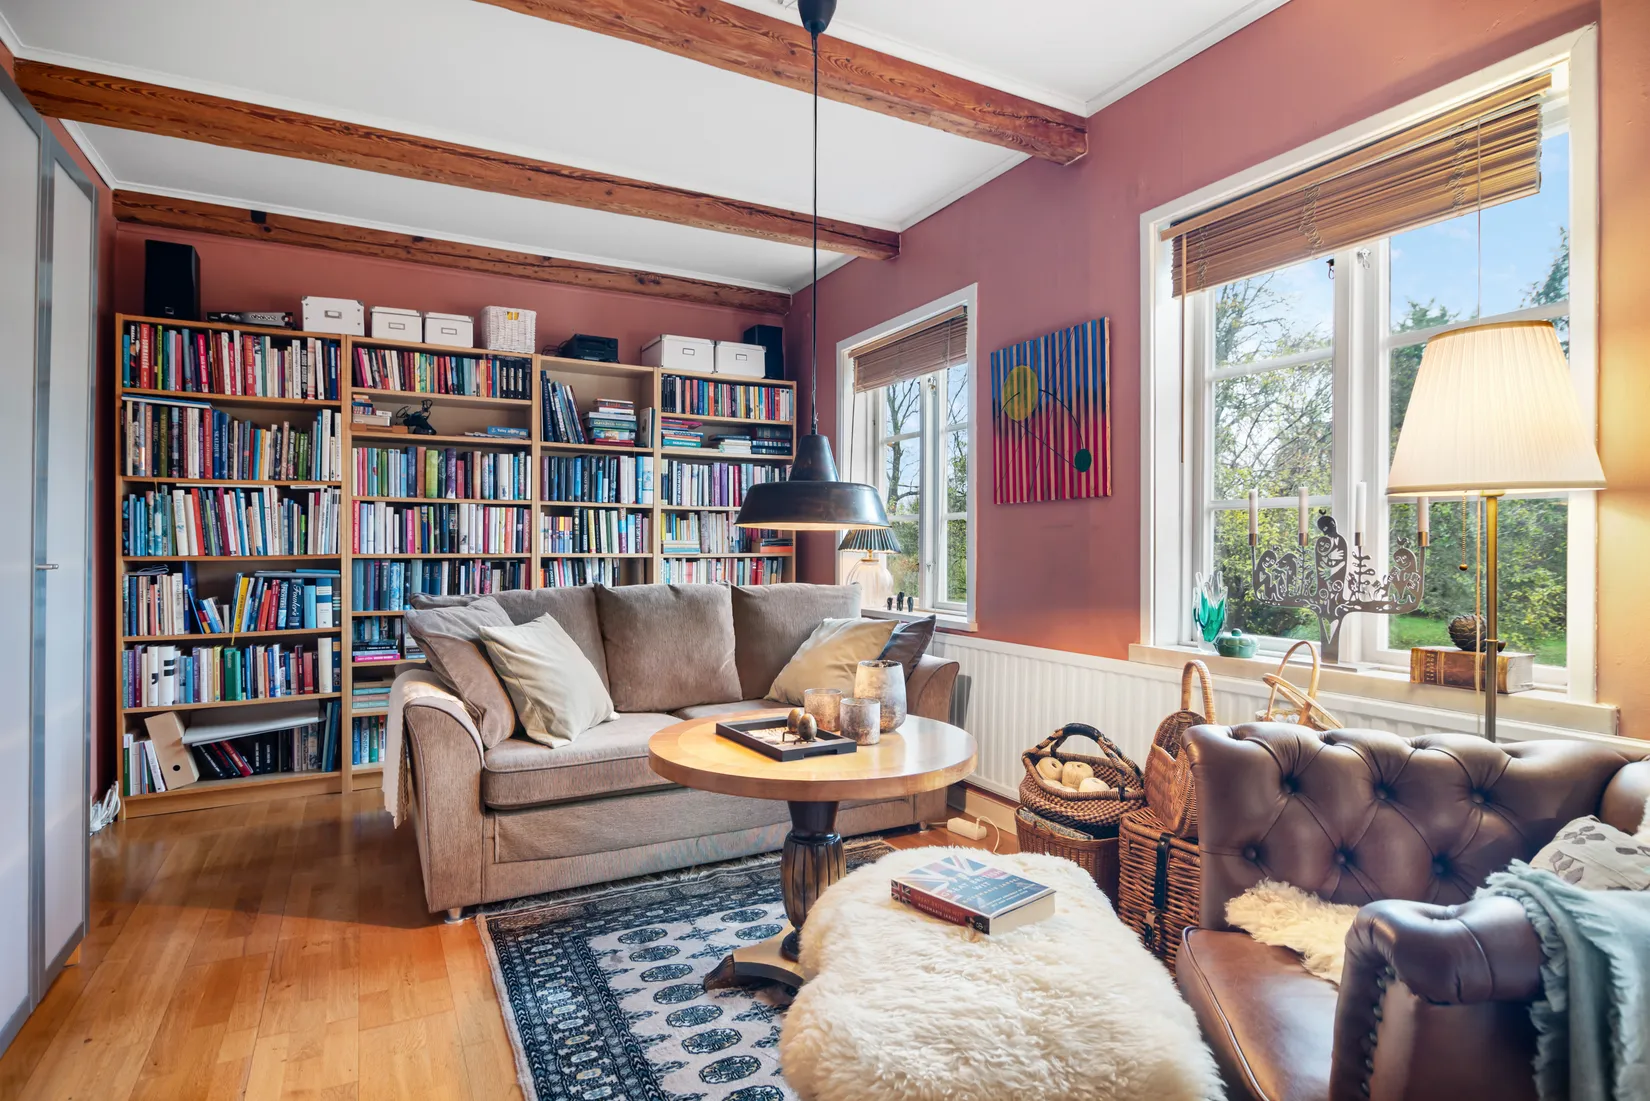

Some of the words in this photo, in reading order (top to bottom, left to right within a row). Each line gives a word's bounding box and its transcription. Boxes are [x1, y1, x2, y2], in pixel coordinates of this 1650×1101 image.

[291, 584, 302, 617] Fowler's
[941, 882, 970, 898] GREAT
[971, 881, 991, 891] WIT
